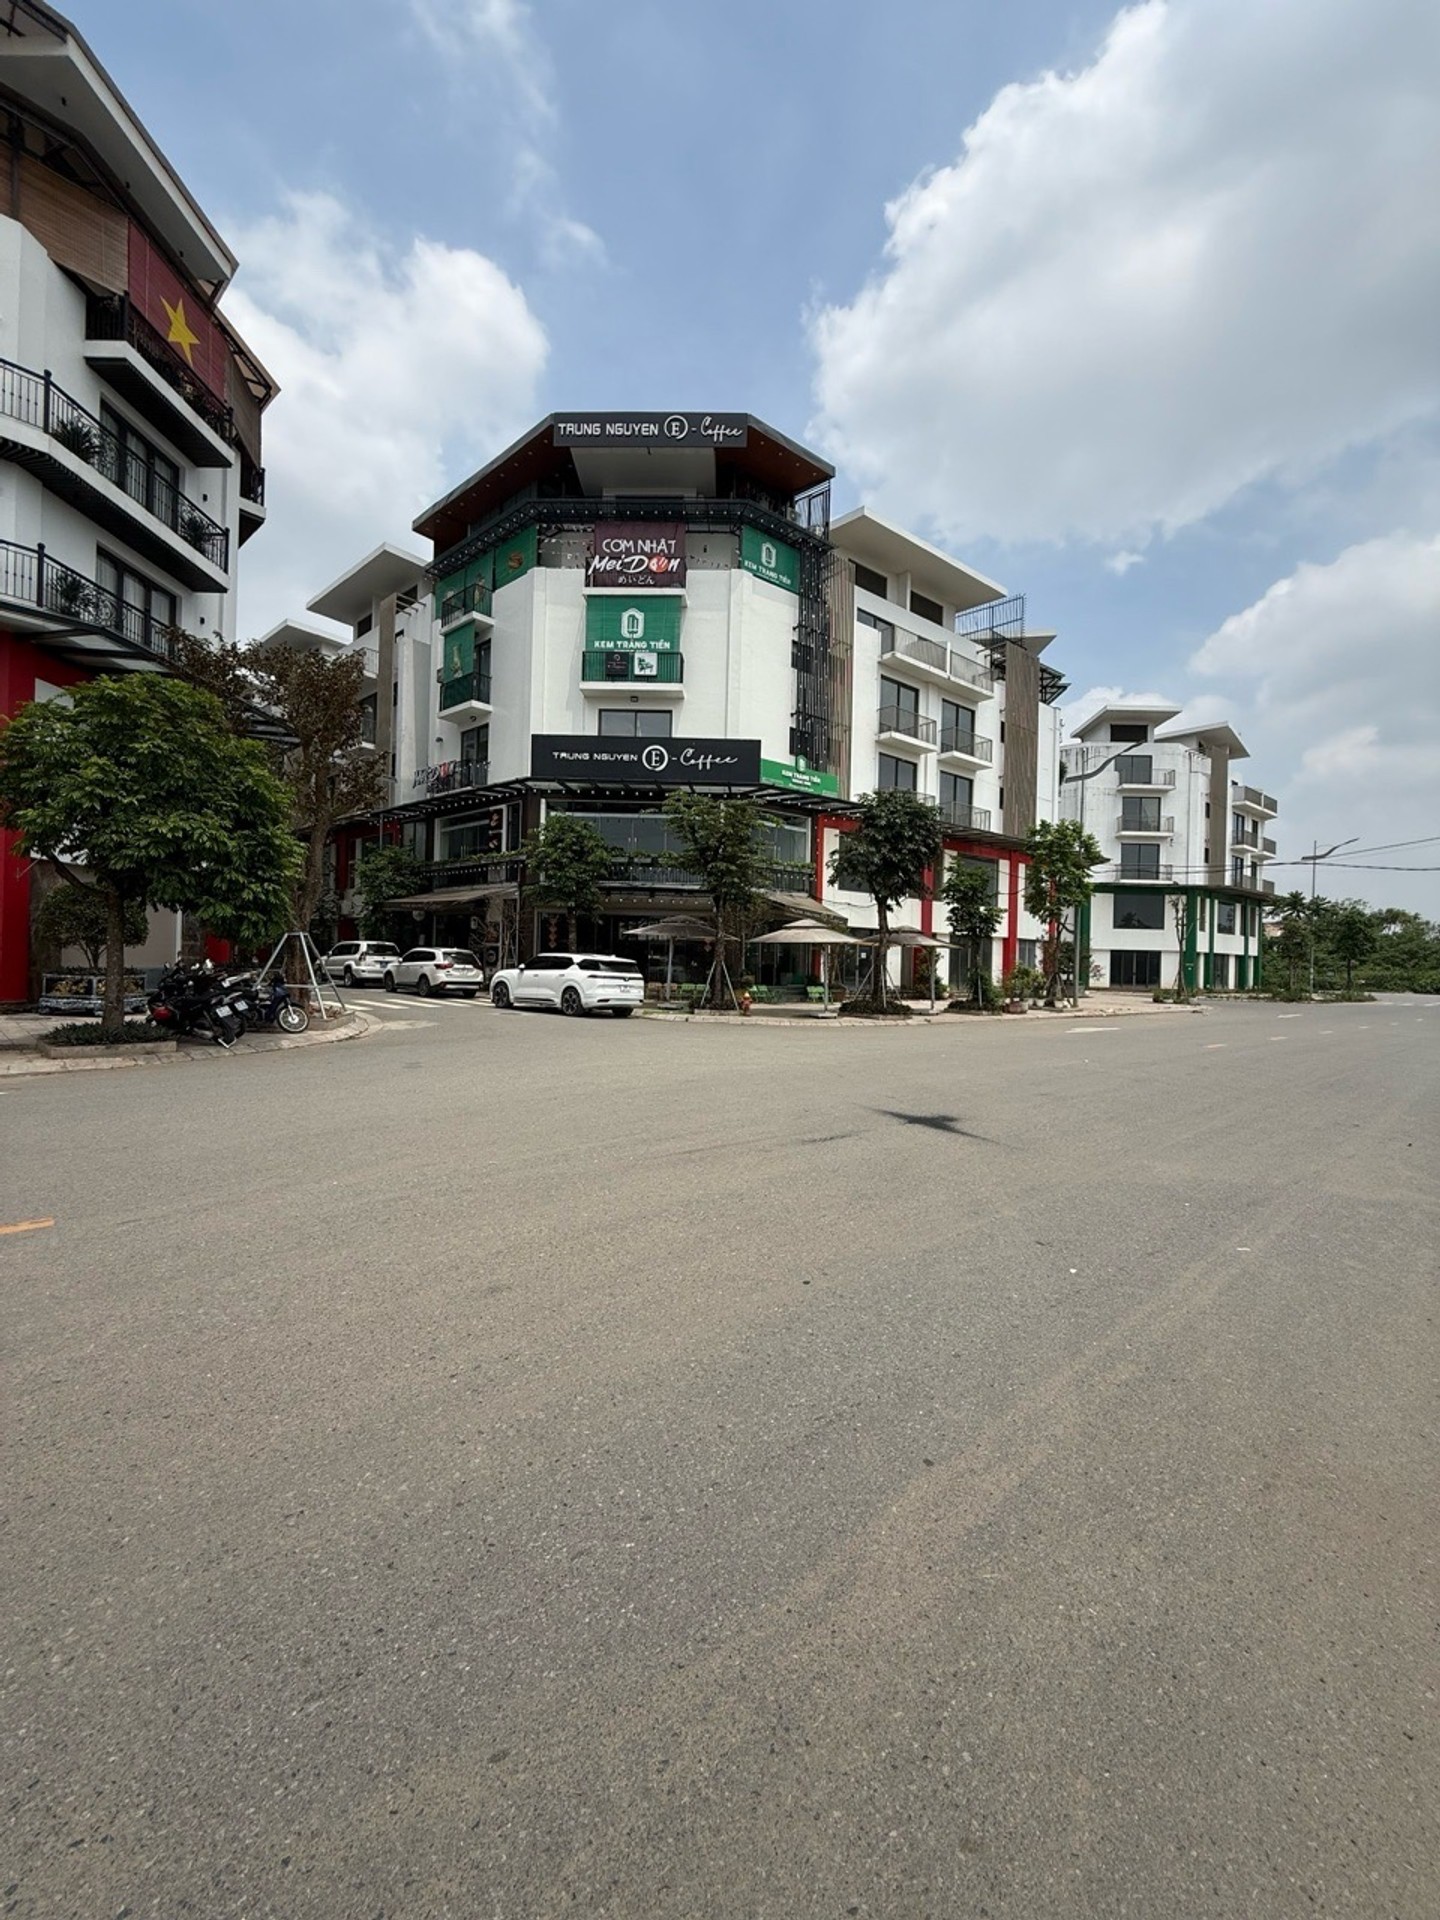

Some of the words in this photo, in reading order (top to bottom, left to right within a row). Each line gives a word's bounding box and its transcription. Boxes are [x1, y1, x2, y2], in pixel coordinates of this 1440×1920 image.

[558, 422, 601, 436] TRUNG
[605, 422, 659, 437] NGUYEN
[700, 415, 743, 442] Coffee
[618, 575, 655, 585] めいどん
[593, 640, 614, 648] KEM
[552, 751, 590, 760] TRUNG
[593, 752, 638, 762] NGUYEN
[680, 747, 738, 770] Coffee
